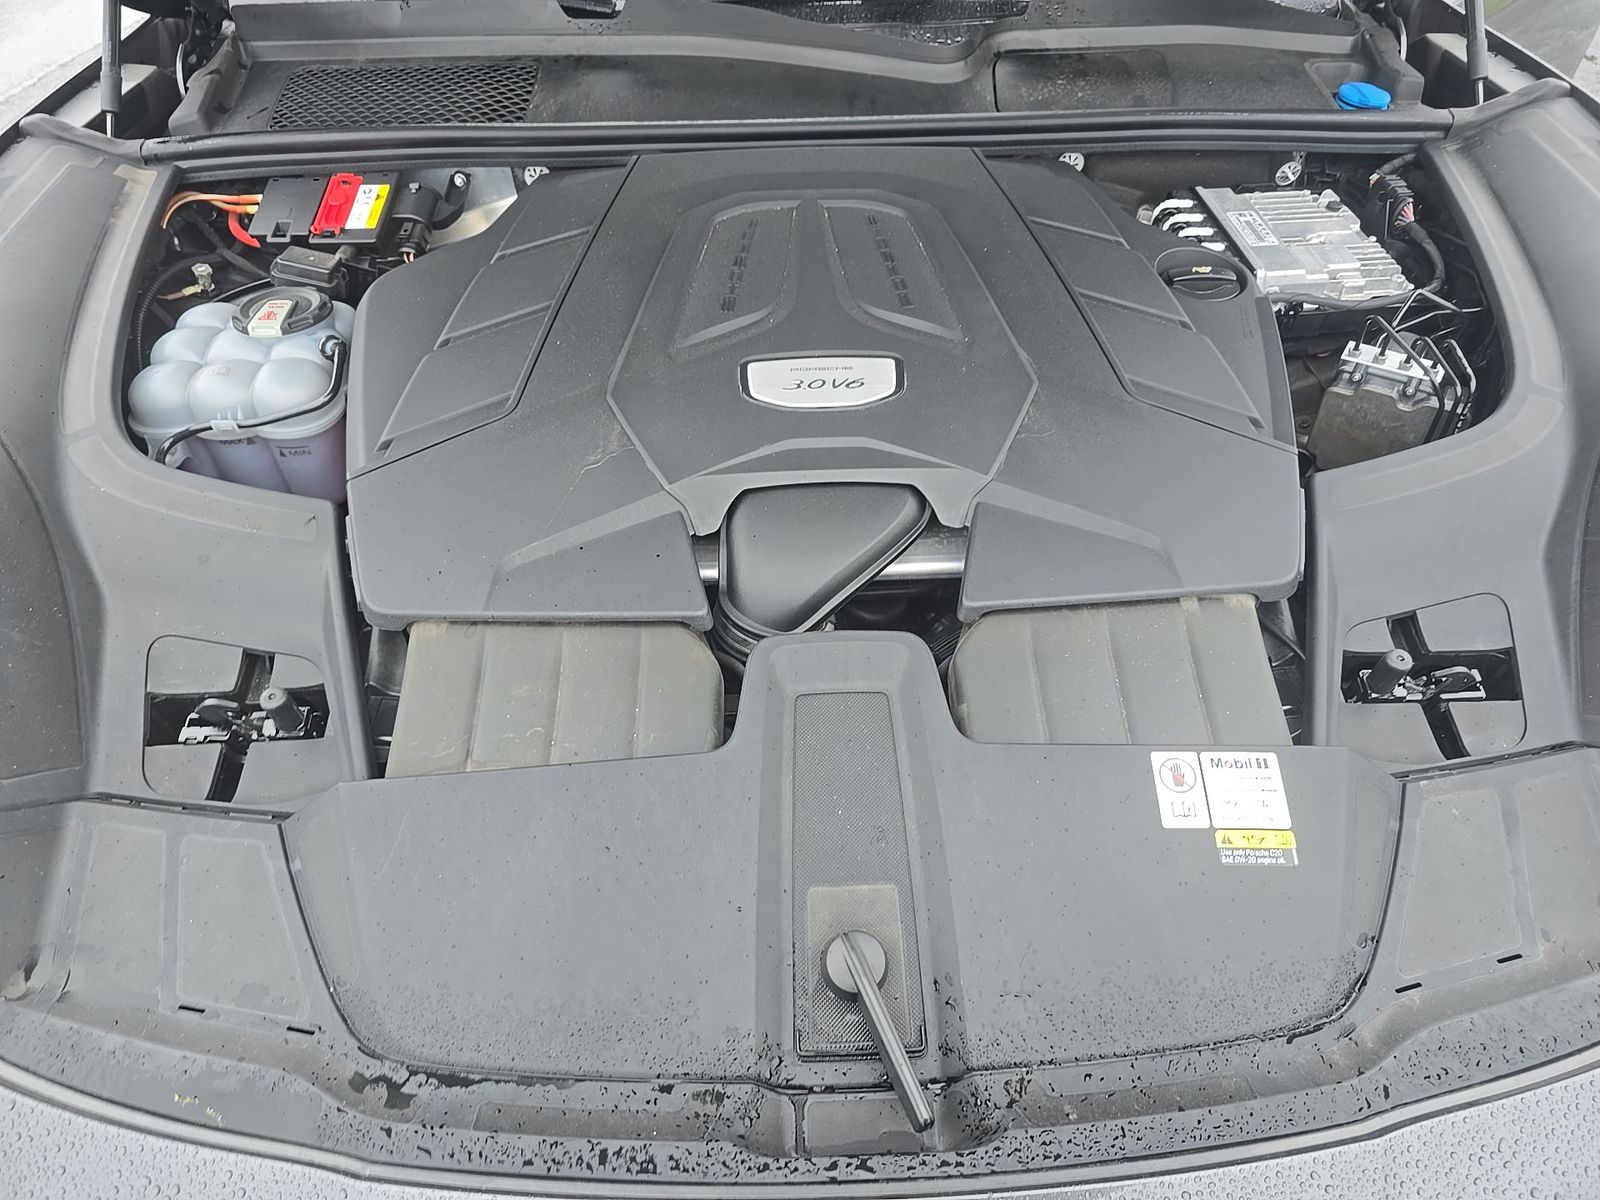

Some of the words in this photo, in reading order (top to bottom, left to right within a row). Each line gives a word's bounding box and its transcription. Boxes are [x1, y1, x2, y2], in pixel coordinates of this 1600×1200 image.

[781, 377, 827, 391] 3.0
[831, 377, 866, 390] V6
[288, 449, 312, 457] MIN
[1210, 757, 1253, 769] Mobil
[1220, 848, 1233, 856] Use
[1233, 848, 1246, 857] only
[1245, 848, 1270, 857] Porsche
[1270, 848, 1283, 857] C20
[1221, 855, 1234, 864] SAE
[1257, 857, 1277, 866] engine
